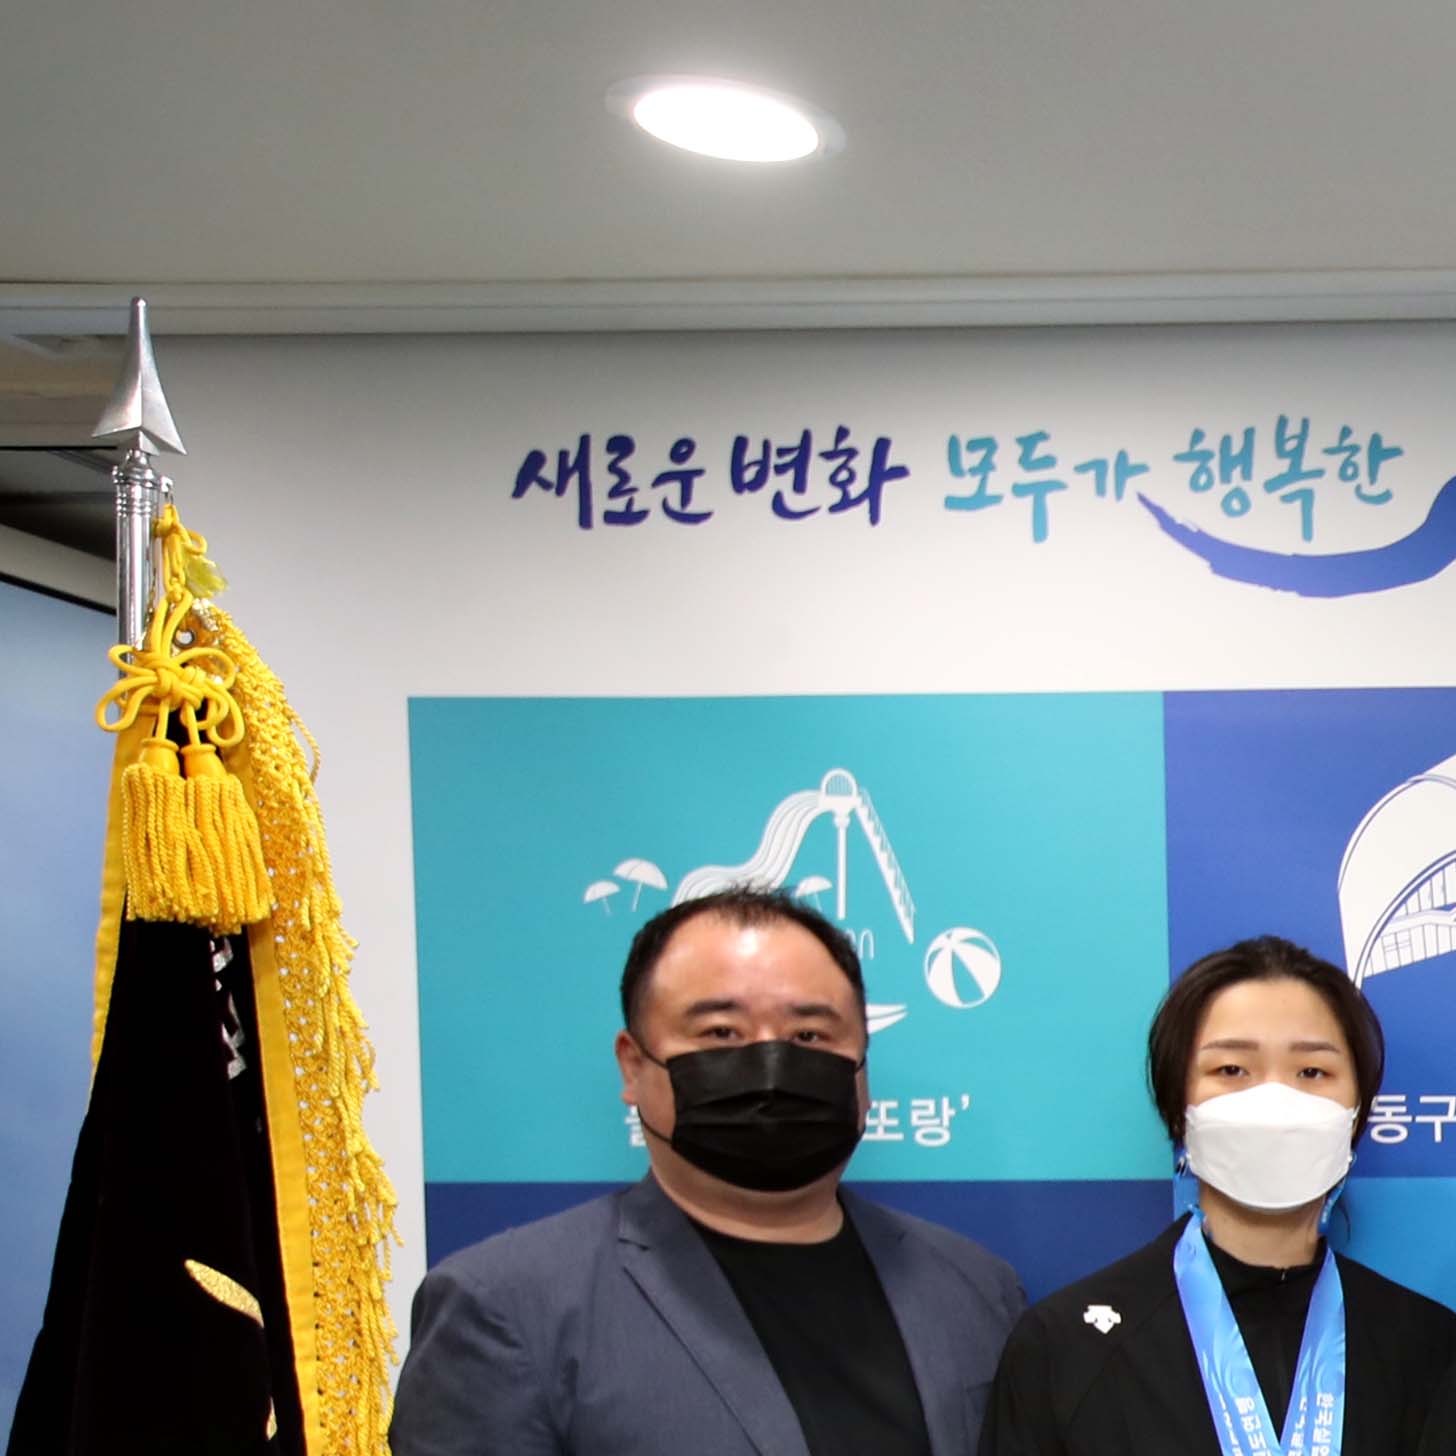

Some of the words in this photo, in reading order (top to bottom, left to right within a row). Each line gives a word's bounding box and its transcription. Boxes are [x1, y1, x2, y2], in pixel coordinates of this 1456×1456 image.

[511, 432, 713, 530] 새로운
[729, 424, 910, 527] 변화
[944, 432, 1147, 542] 모두가
[1172, 416, 1405, 542] 행복한
